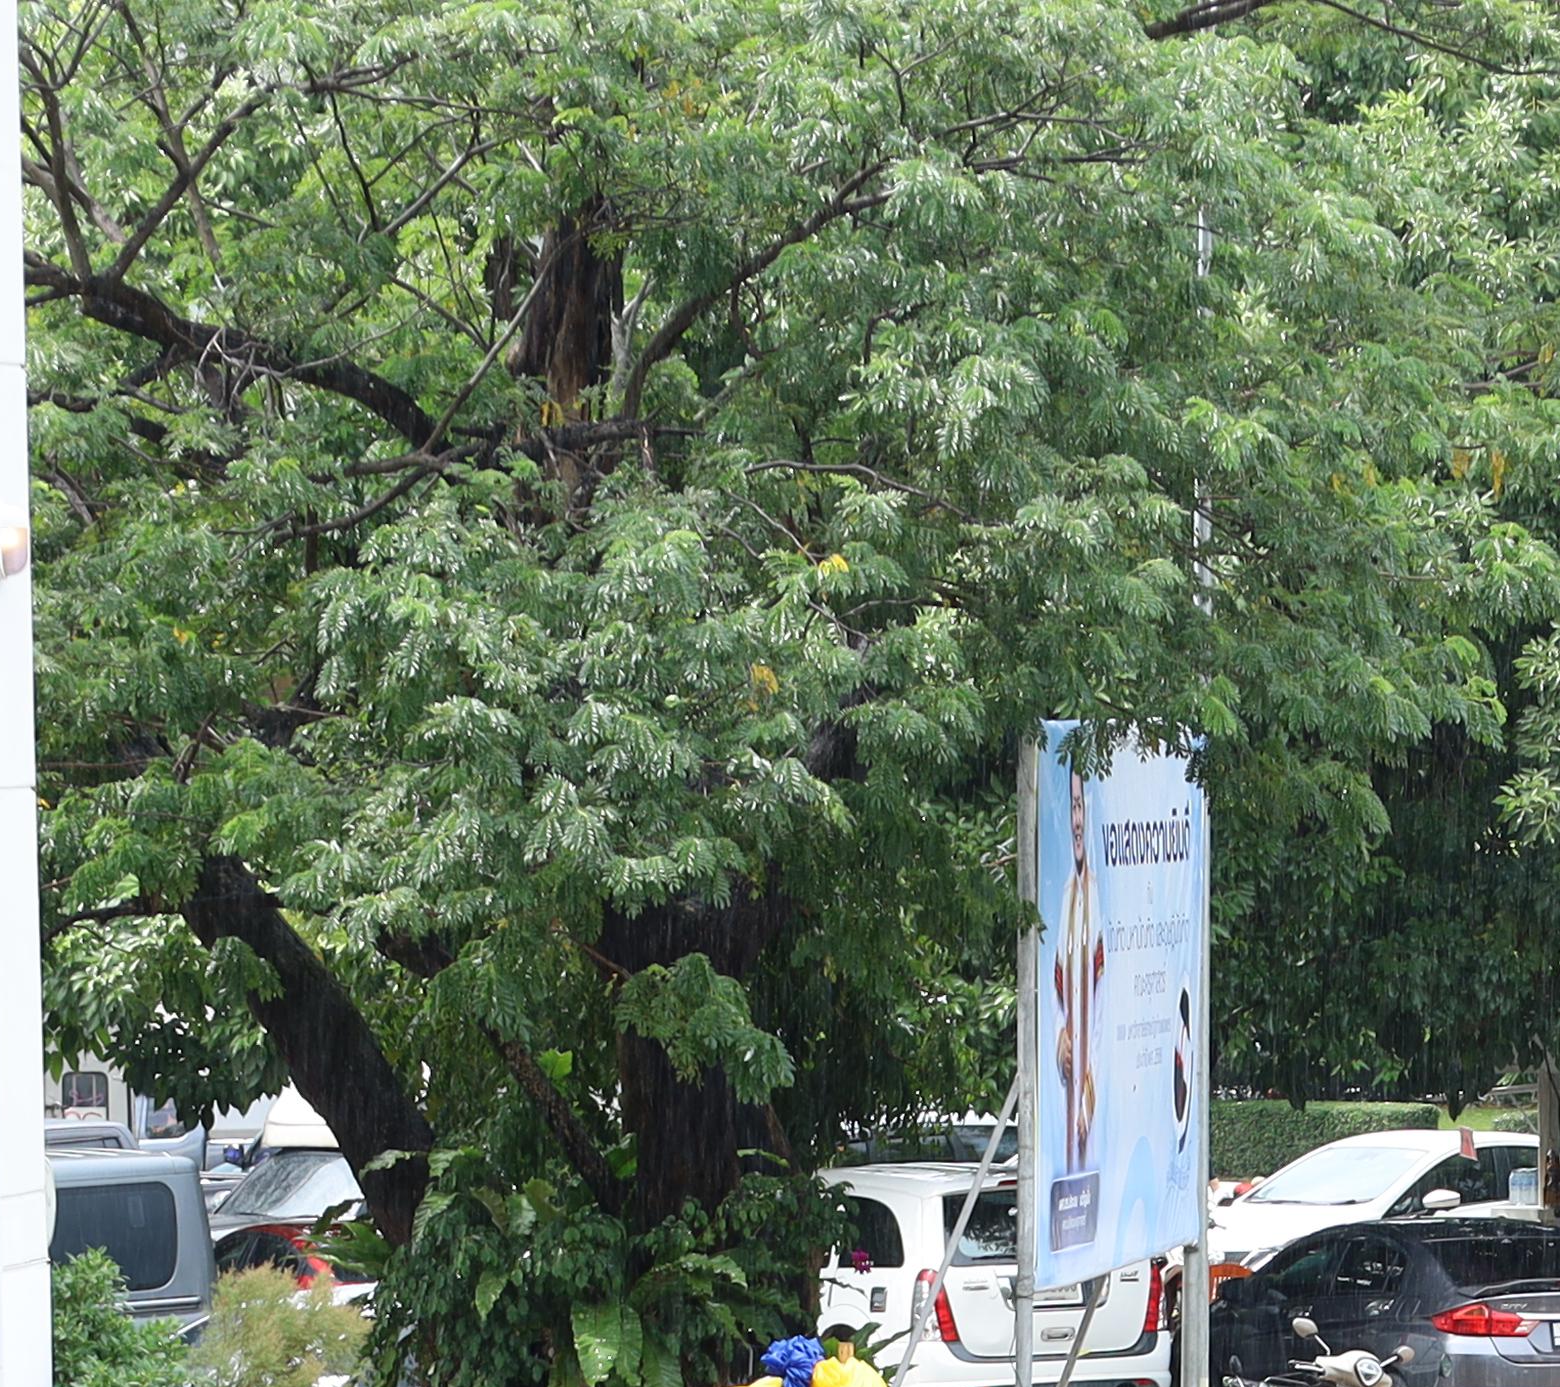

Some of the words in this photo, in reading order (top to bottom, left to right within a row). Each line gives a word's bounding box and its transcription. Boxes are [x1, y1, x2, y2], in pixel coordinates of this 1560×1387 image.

[1102, 800, 1191, 867] ขอแสดงความยินดี
